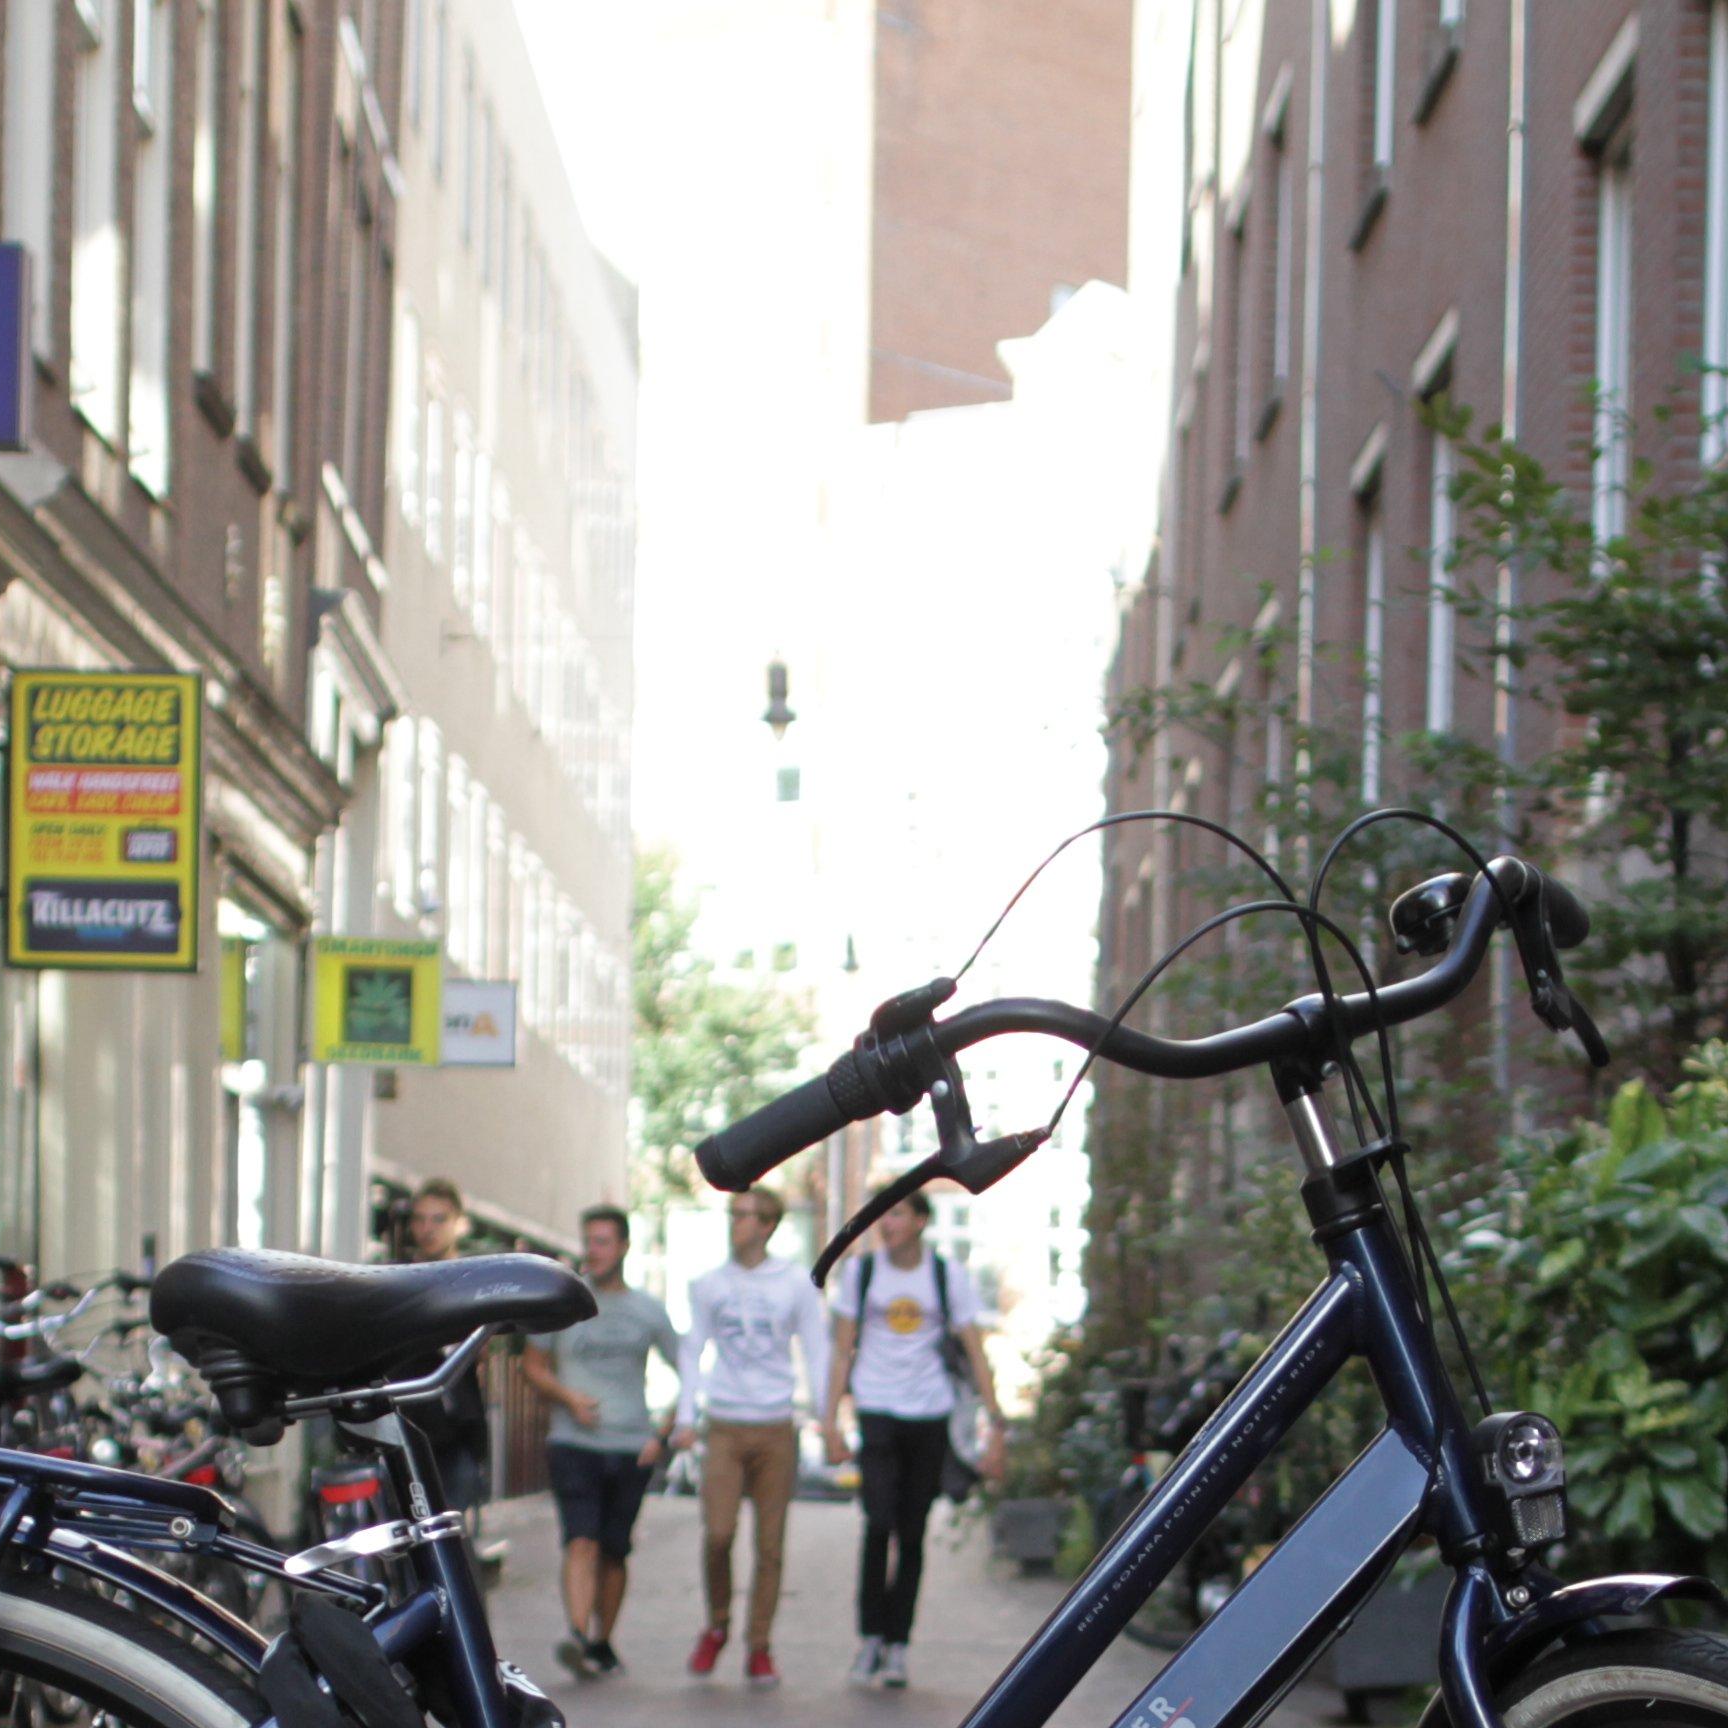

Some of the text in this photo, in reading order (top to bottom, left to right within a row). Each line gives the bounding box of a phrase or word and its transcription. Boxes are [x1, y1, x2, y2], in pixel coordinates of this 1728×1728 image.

[33, 688, 178, 722] LUGGAGE
[33, 723, 179, 760] STORAGE
[1077, 1594, 1110, 1632] RENT
[1164, 1453, 1228, 1529] POINTER
[1231, 1383, 1287, 1448] NOFLIK
[1289, 1338, 1325, 1379] RIDE
